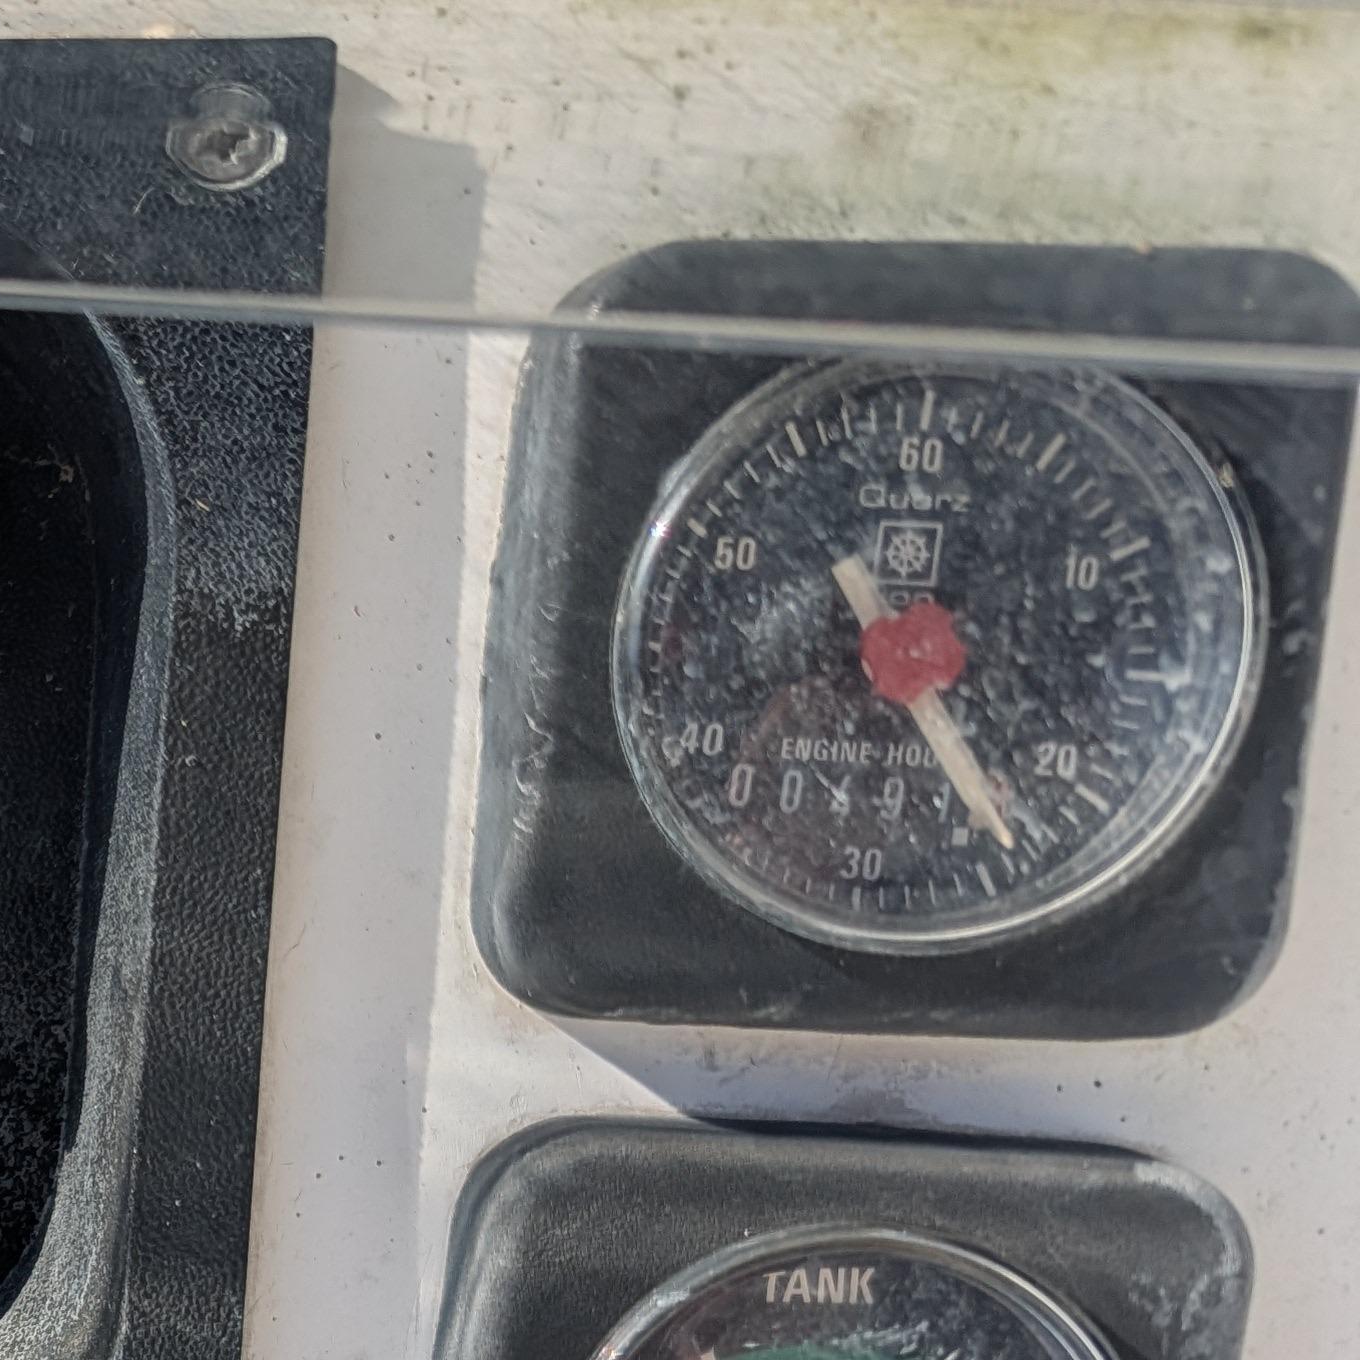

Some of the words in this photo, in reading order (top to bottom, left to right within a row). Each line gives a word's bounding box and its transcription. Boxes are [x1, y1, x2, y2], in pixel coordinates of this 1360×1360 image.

[898, 438, 943, 472] 60
[714, 538, 757, 570] 50
[1064, 553, 1100, 591] 10
[679, 723, 724, 756] 40
[780, 737, 872, 764] ENGINE
[886, 744, 940, 768] HOU
[1034, 742, 1077, 779] 20
[840, 846, 882, 882] 30
[762, 1266, 876, 1305] TANK
